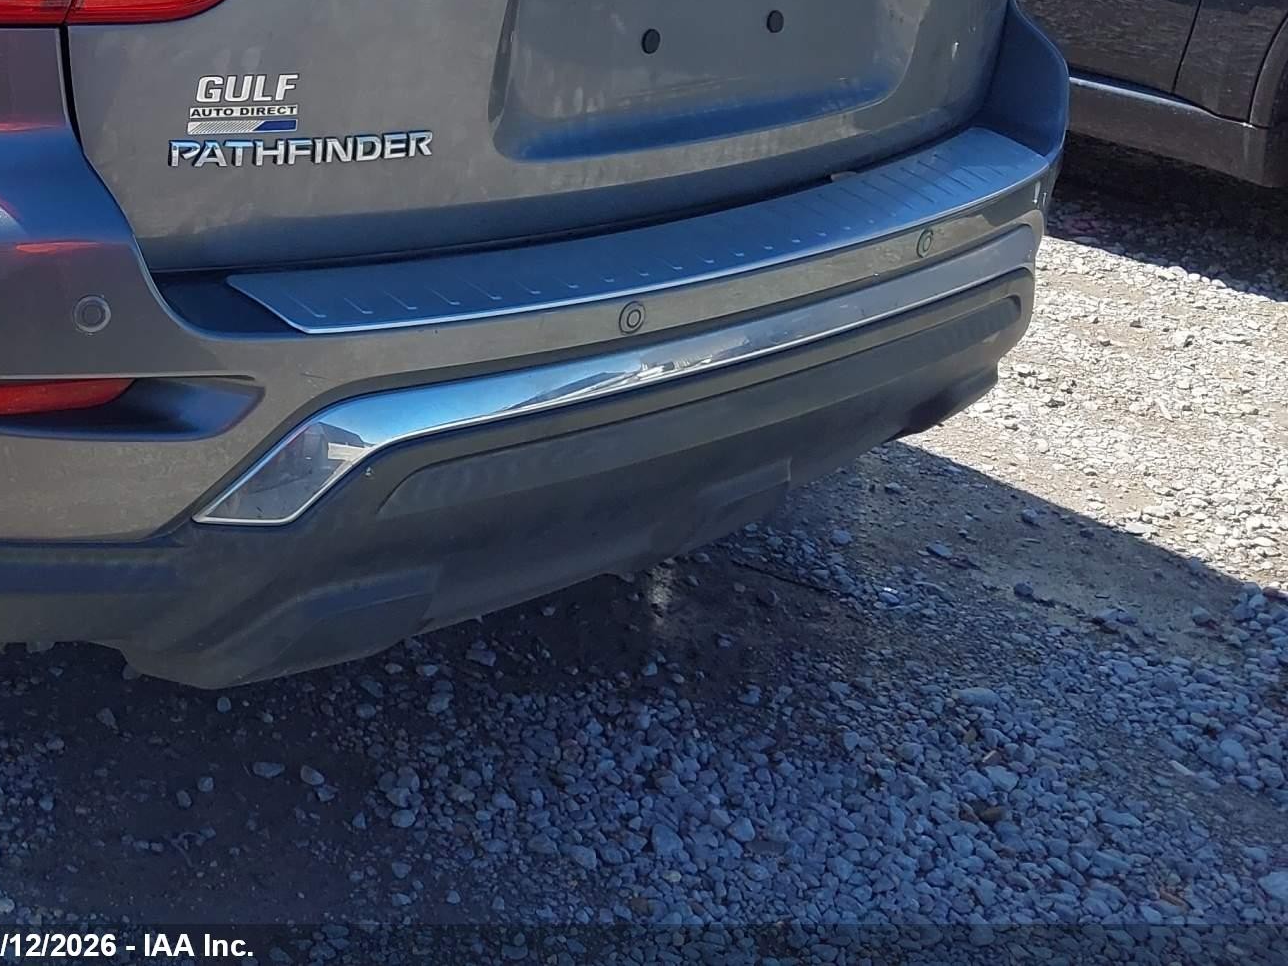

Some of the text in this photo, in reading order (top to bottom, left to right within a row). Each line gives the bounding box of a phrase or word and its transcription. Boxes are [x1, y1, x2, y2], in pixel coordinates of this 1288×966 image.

[195, 73, 299, 103] GULF
[190, 106, 297, 117] AUTO DIRECT
[168, 131, 433, 167] PATHFINDER
